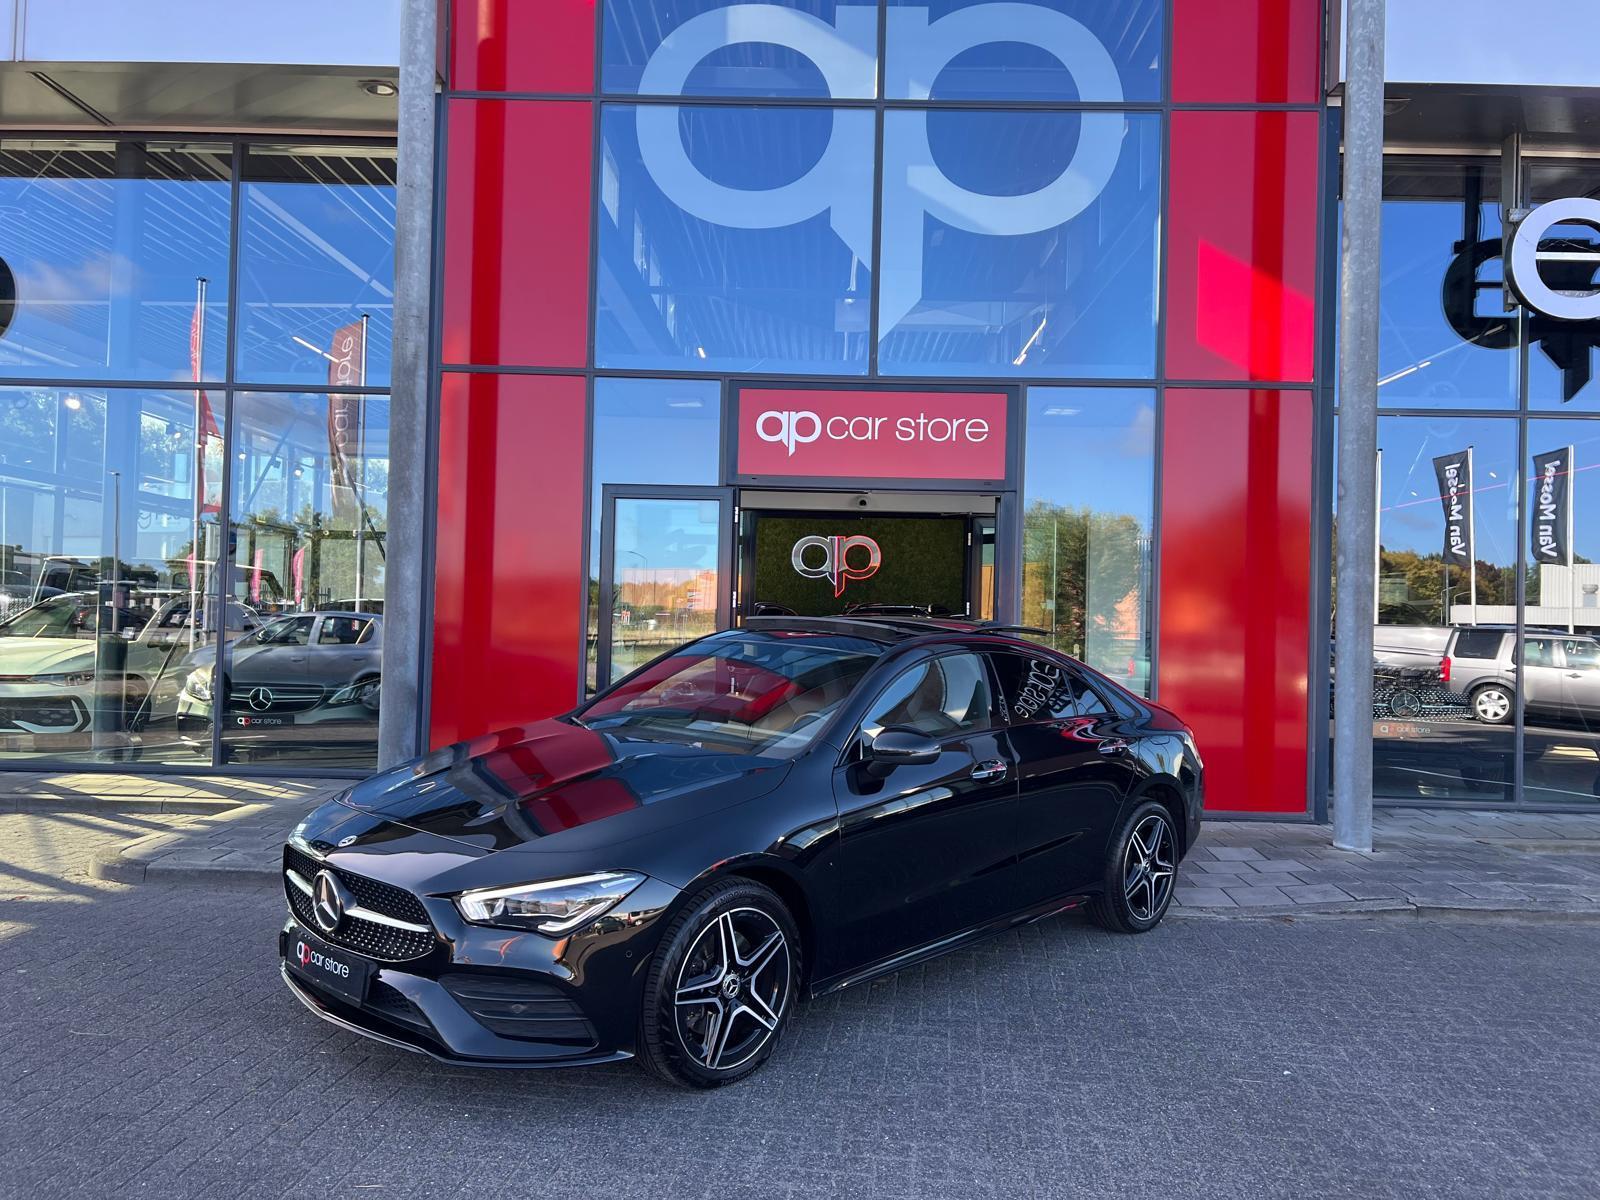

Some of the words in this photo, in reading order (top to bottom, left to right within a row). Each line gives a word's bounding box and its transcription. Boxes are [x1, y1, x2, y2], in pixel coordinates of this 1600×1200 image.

[756, 410, 822, 457] ap
[827, 416, 888, 440] car
[896, 412, 989, 442] store
[791, 535, 881, 598] ap
[297, 941, 311, 969] ap
[311, 951, 325, 967] car
[325, 957, 349, 978] store
